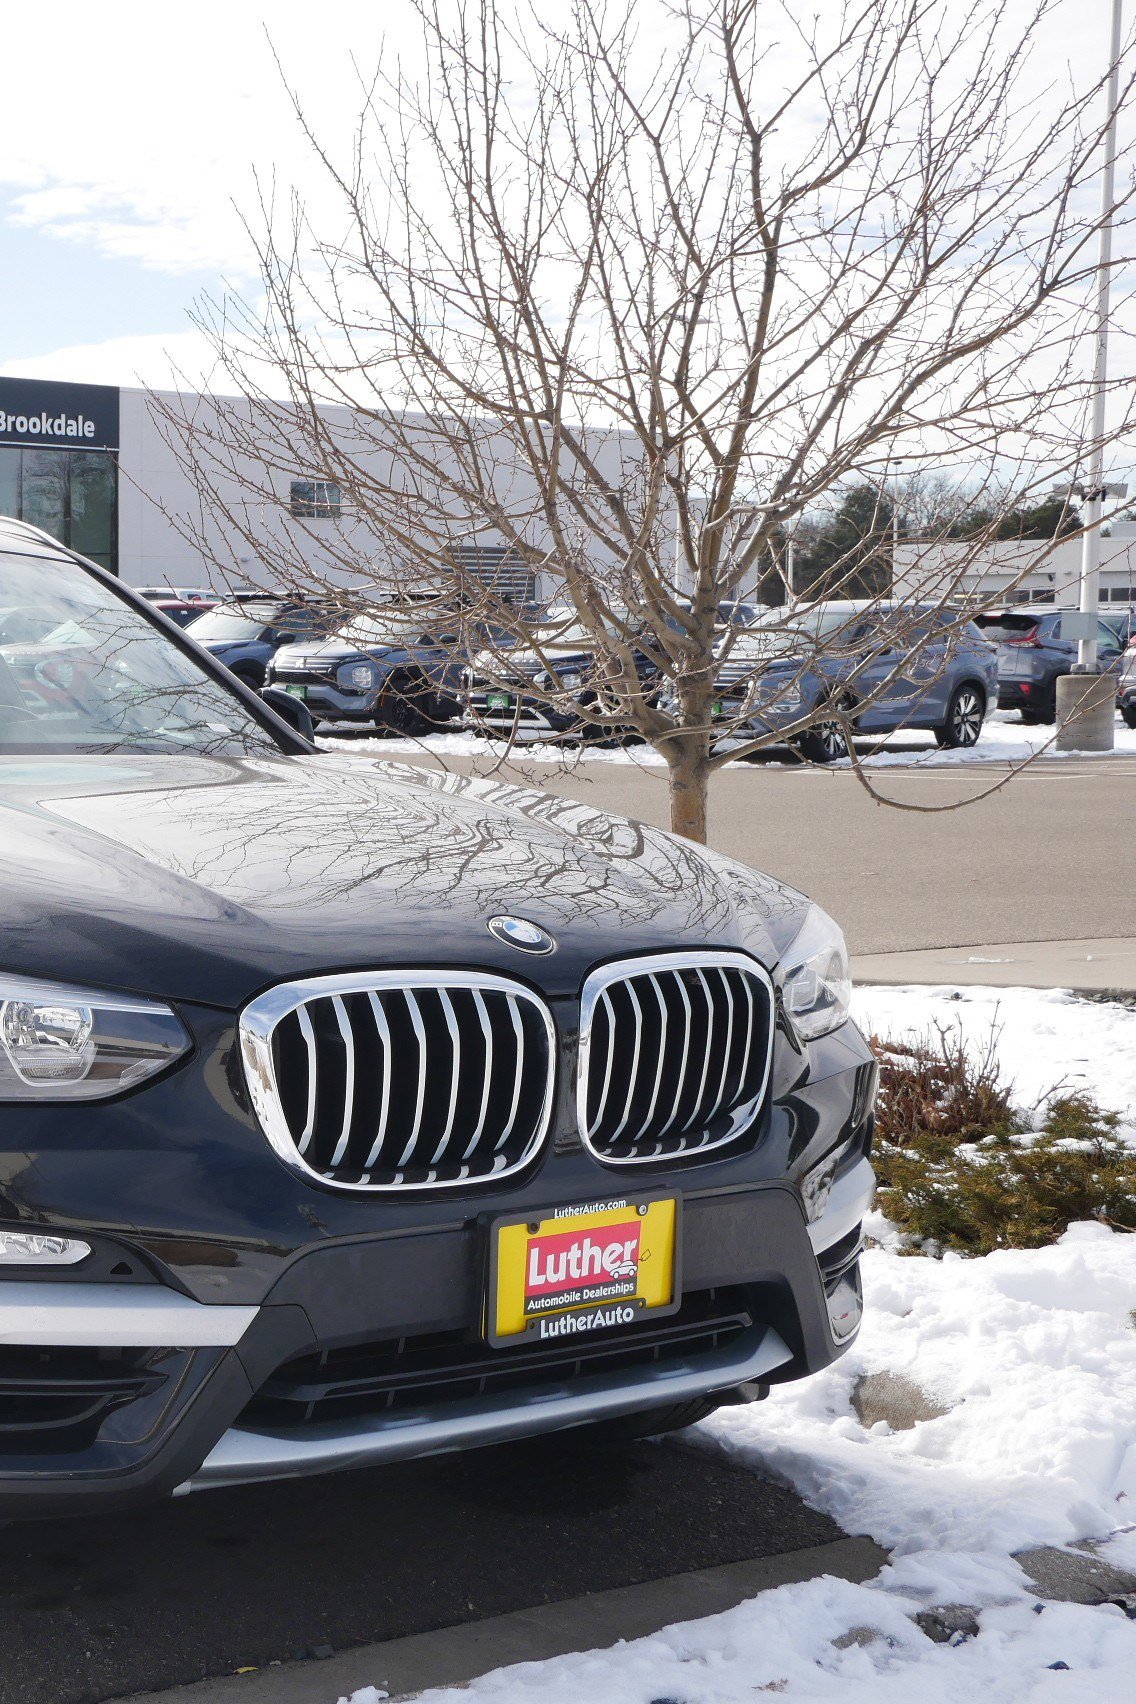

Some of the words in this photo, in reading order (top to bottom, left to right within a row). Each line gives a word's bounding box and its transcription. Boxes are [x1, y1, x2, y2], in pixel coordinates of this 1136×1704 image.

[554, 1199, 627, 1219] LutherAuto.com
[528, 1237, 638, 1287] Luther
[527, 1291, 581, 1310] Automobile
[583, 1281, 634, 1299] Dealerships
[540, 1305, 634, 1338] LutherAuto
